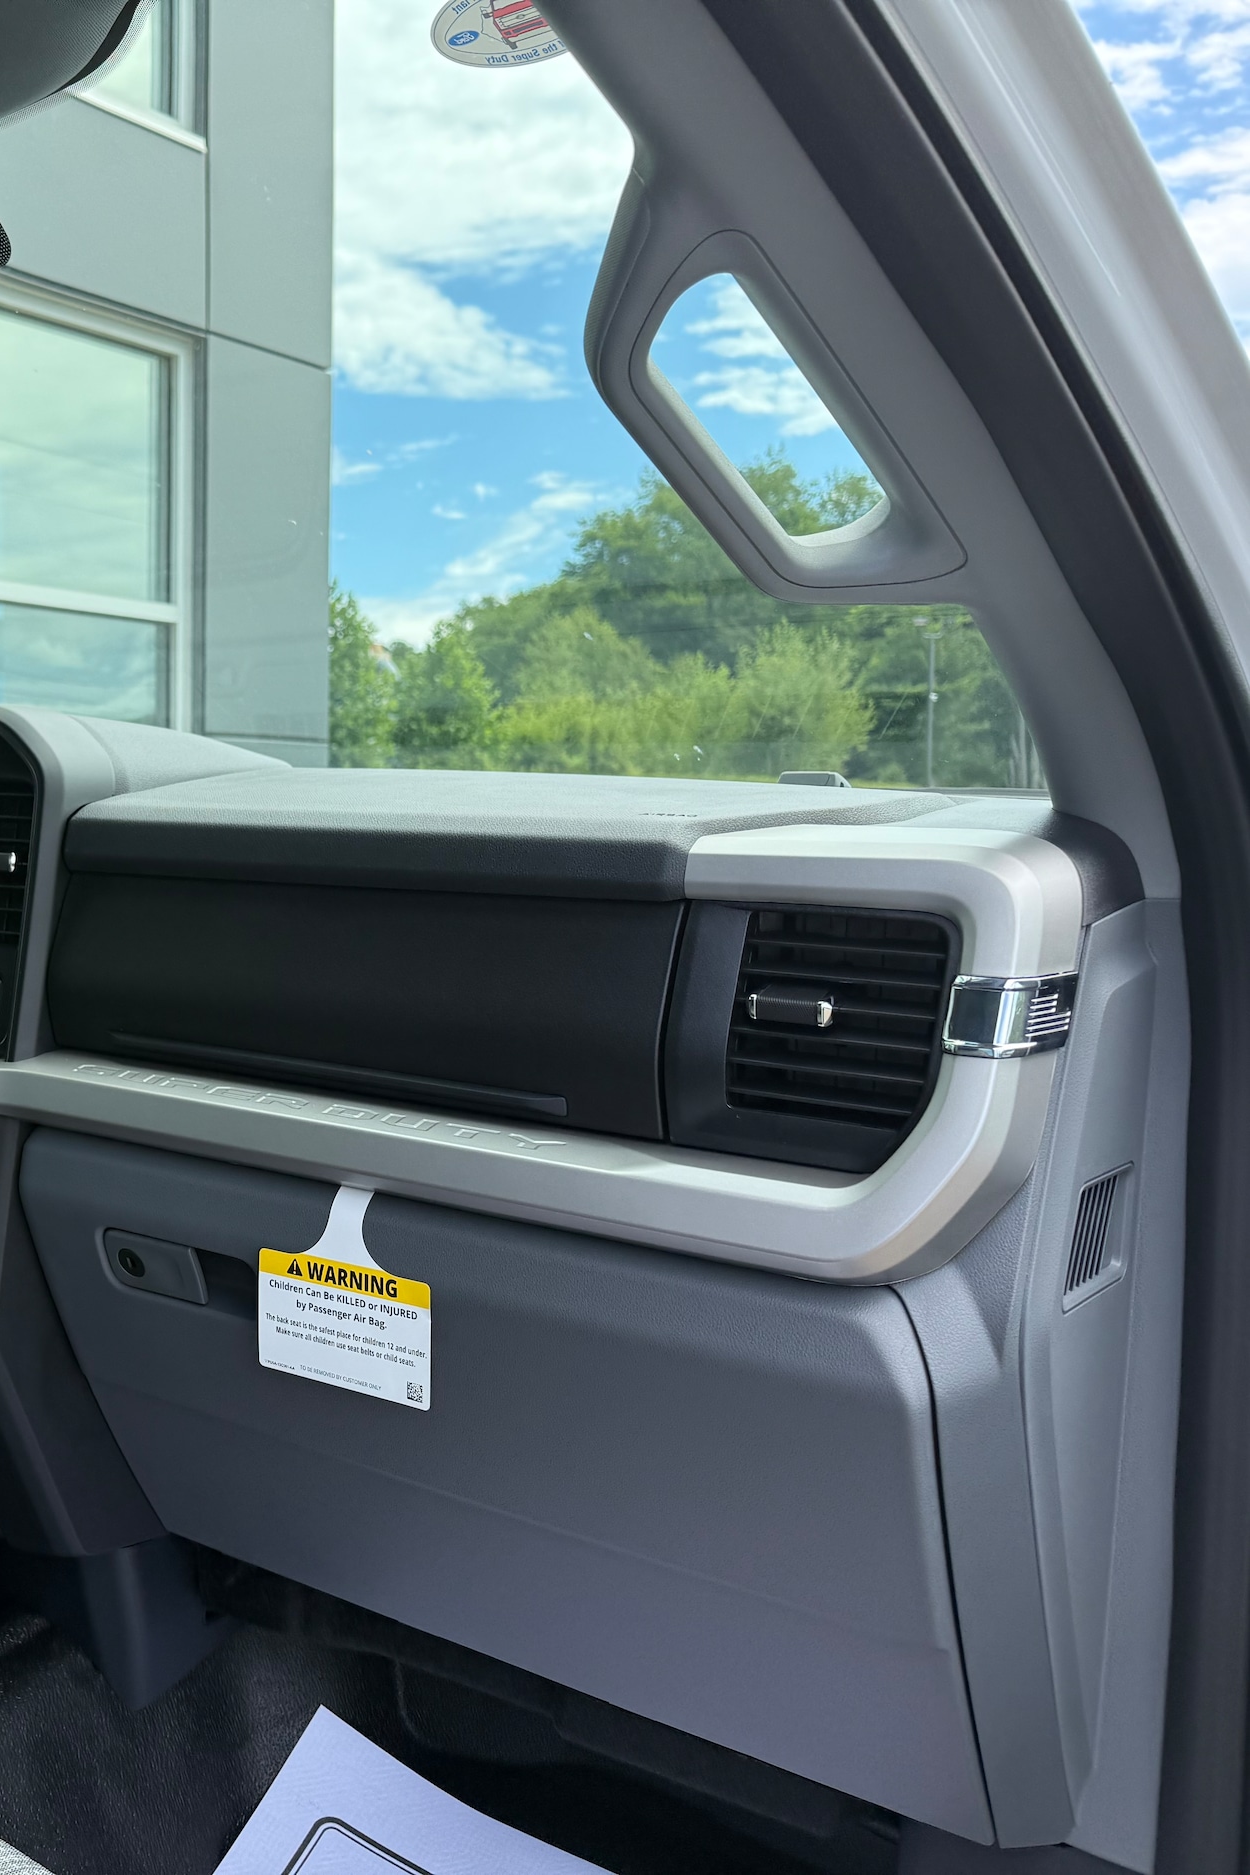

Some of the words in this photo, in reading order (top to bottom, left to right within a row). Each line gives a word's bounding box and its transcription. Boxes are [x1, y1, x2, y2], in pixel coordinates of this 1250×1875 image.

[71, 1063, 309, 1110] SUPER
[320, 1103, 567, 1151] DUTY
[269, 1279, 303, 1294] Children
[305, 1287, 322, 1298] Can
[323, 1291, 335, 1301] Be
[336, 1293, 366, 1308] KILLED
[368, 1302, 378, 1311] or
[380, 1303, 418, 1320] INJURED
[307, 1261, 398, 1298] WARNING
[265, 1312, 276, 1321] The
[276, 1315, 289, 1325] back
[290, 1319, 302, 1328] seat
[308, 1323, 318, 1331] the
[318, 1326, 336, 1336] safest
[336, 1330, 351, 1340] place
[352, 1333, 361, 1342] for
[362, 1336, 386, 1349] children
[395, 1345, 407, 1354] and
[407, 1348, 428, 1359] under.
[296, 1299, 307, 1311] by
[308, 1302, 352, 1320] Passenger
[353, 1313, 366, 1323] Air
[368, 1316, 387, 1331] Bag.
[275, 1326, 291, 1336] Make
[291, 1331, 304, 1340] sure
[304, 1333, 312, 1342] all
[312, 1335, 336, 1347] children
[336, 1342, 346, 1350] use
[347, 1345, 360, 1354] seat
[360, 1346, 375, 1357] belts
[383, 1353, 398, 1363] child
[398, 1357, 416, 1368] seats.
[313, 1369, 336, 1379] REMOVED
[342, 1376, 368, 1388] CUSTOMER
[368, 1382, 382, 1391] ONLY
